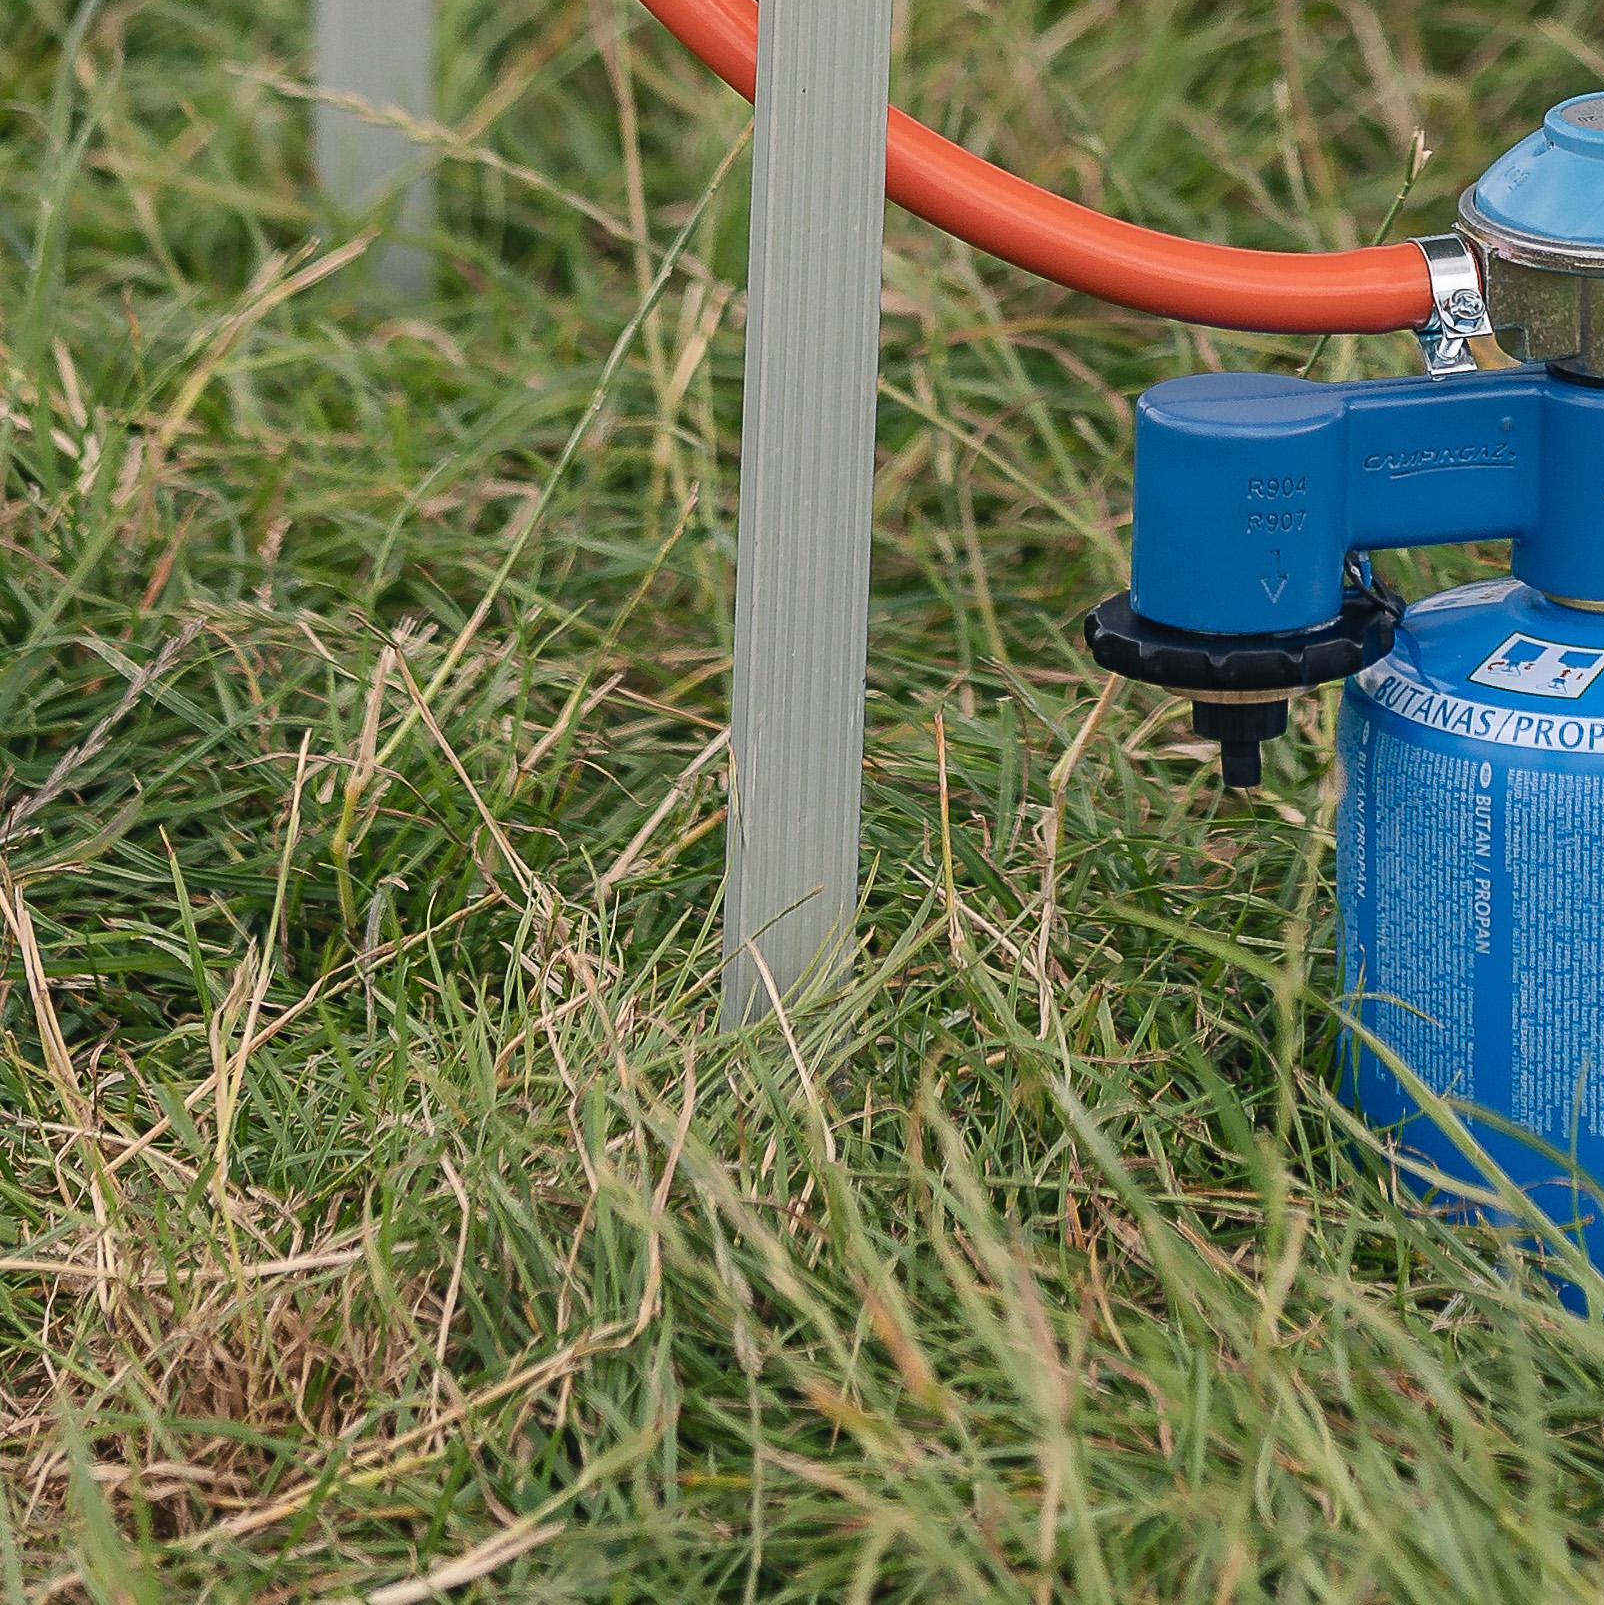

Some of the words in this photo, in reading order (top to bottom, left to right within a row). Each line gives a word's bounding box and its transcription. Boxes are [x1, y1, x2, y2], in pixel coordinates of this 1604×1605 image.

[1247, 476, 1308, 500] R904
[1246, 509, 1307, 534] R907
[1474, 794, 1492, 858] BUTAN
[1474, 877, 1492, 955] PROPAN
